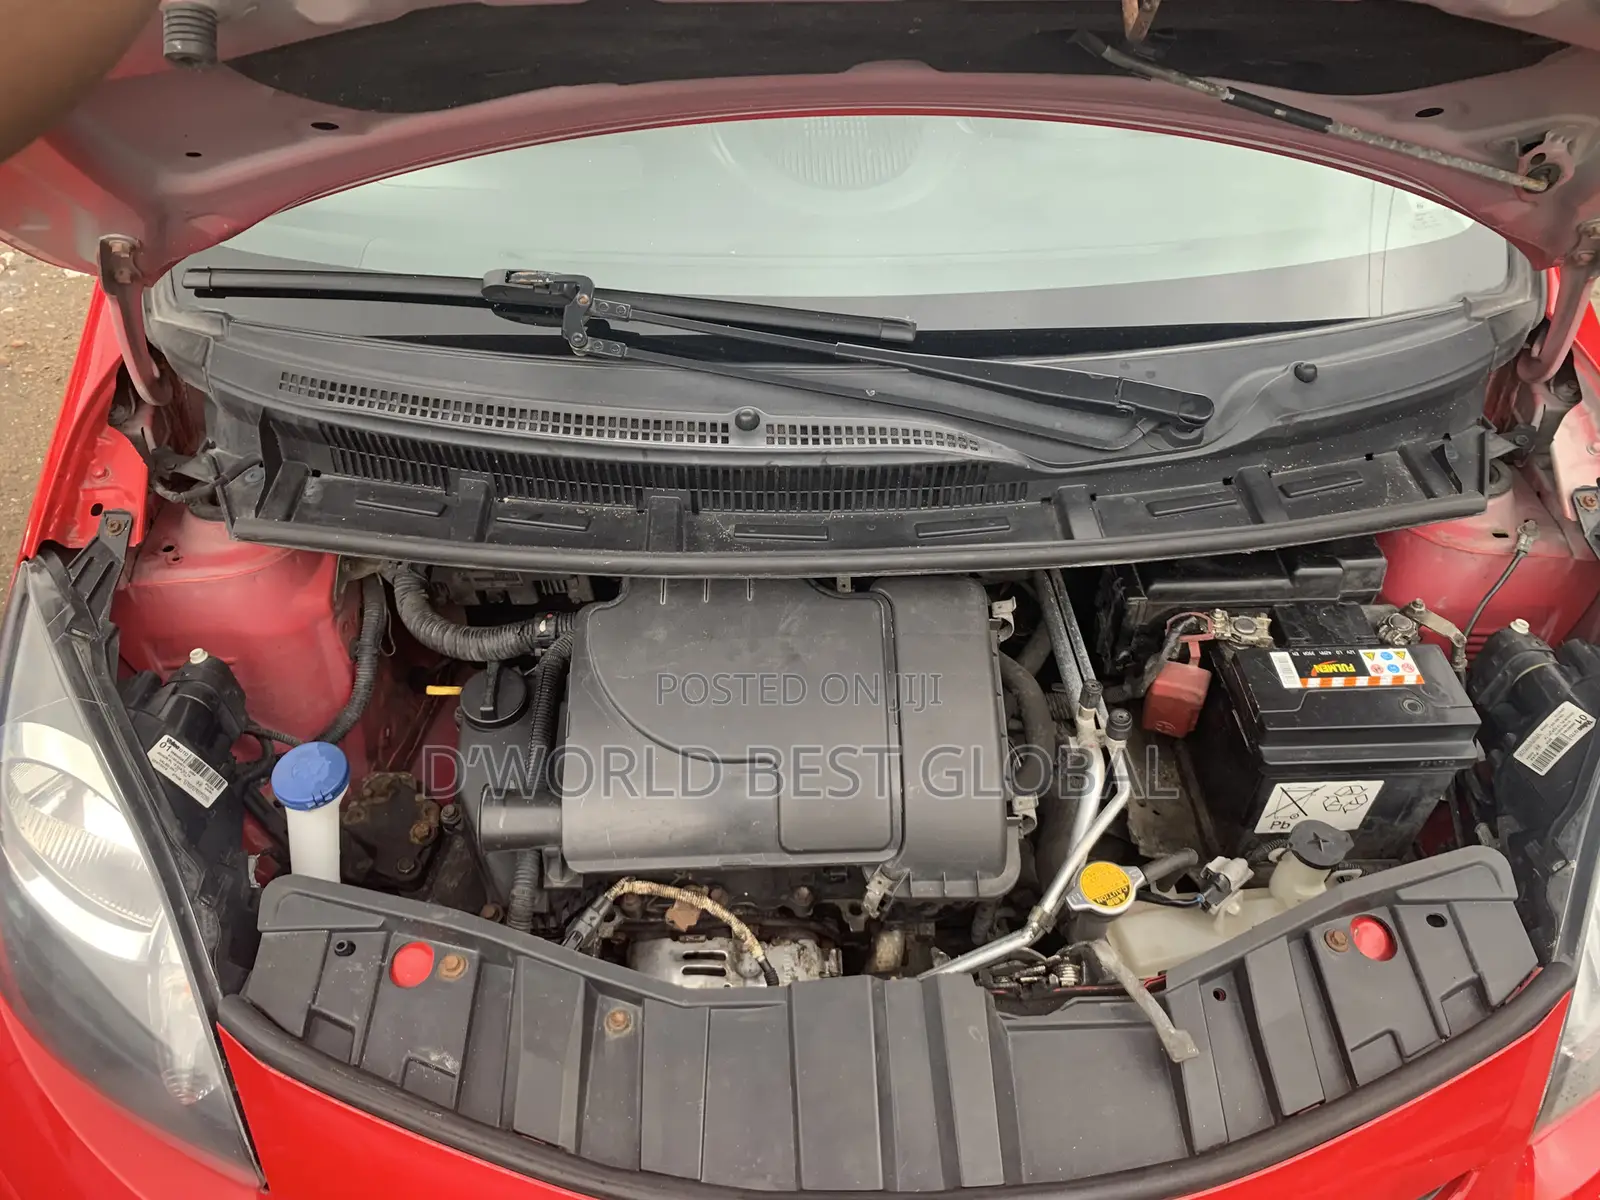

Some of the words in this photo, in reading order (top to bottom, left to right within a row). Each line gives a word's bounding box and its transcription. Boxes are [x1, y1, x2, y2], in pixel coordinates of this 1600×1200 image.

[1313, 663, 1356, 673] FULMEN
[1575, 714, 1588, 725] 01
[159, 742, 172, 752] 01
[1270, 821, 1291, 830] Pb
[1096, 886, 1128, 904] CAUTION
